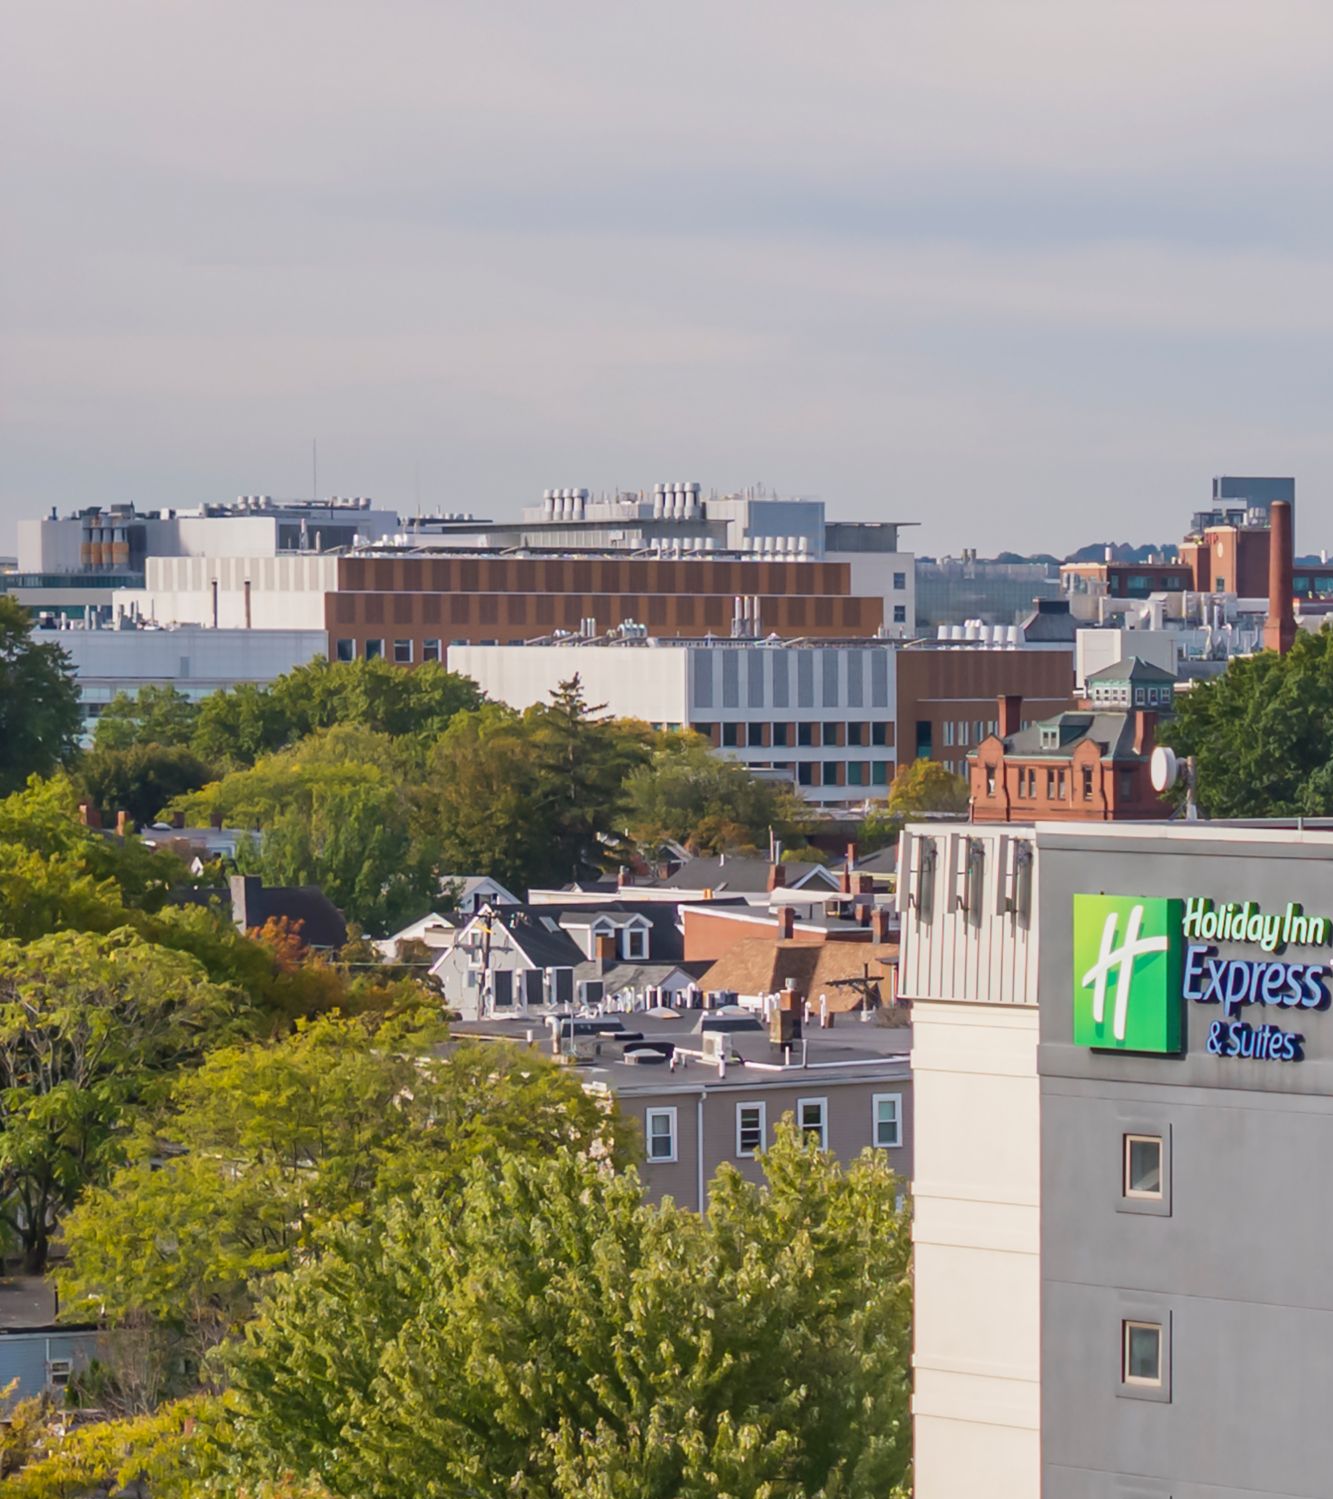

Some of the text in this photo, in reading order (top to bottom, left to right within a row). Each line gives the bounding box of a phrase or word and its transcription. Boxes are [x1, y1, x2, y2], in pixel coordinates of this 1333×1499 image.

[1182, 896, 1329, 952] Holiday Inn
[1182, 944, 1326, 1017] Express
[1206, 1019, 1300, 1061] & Suites
